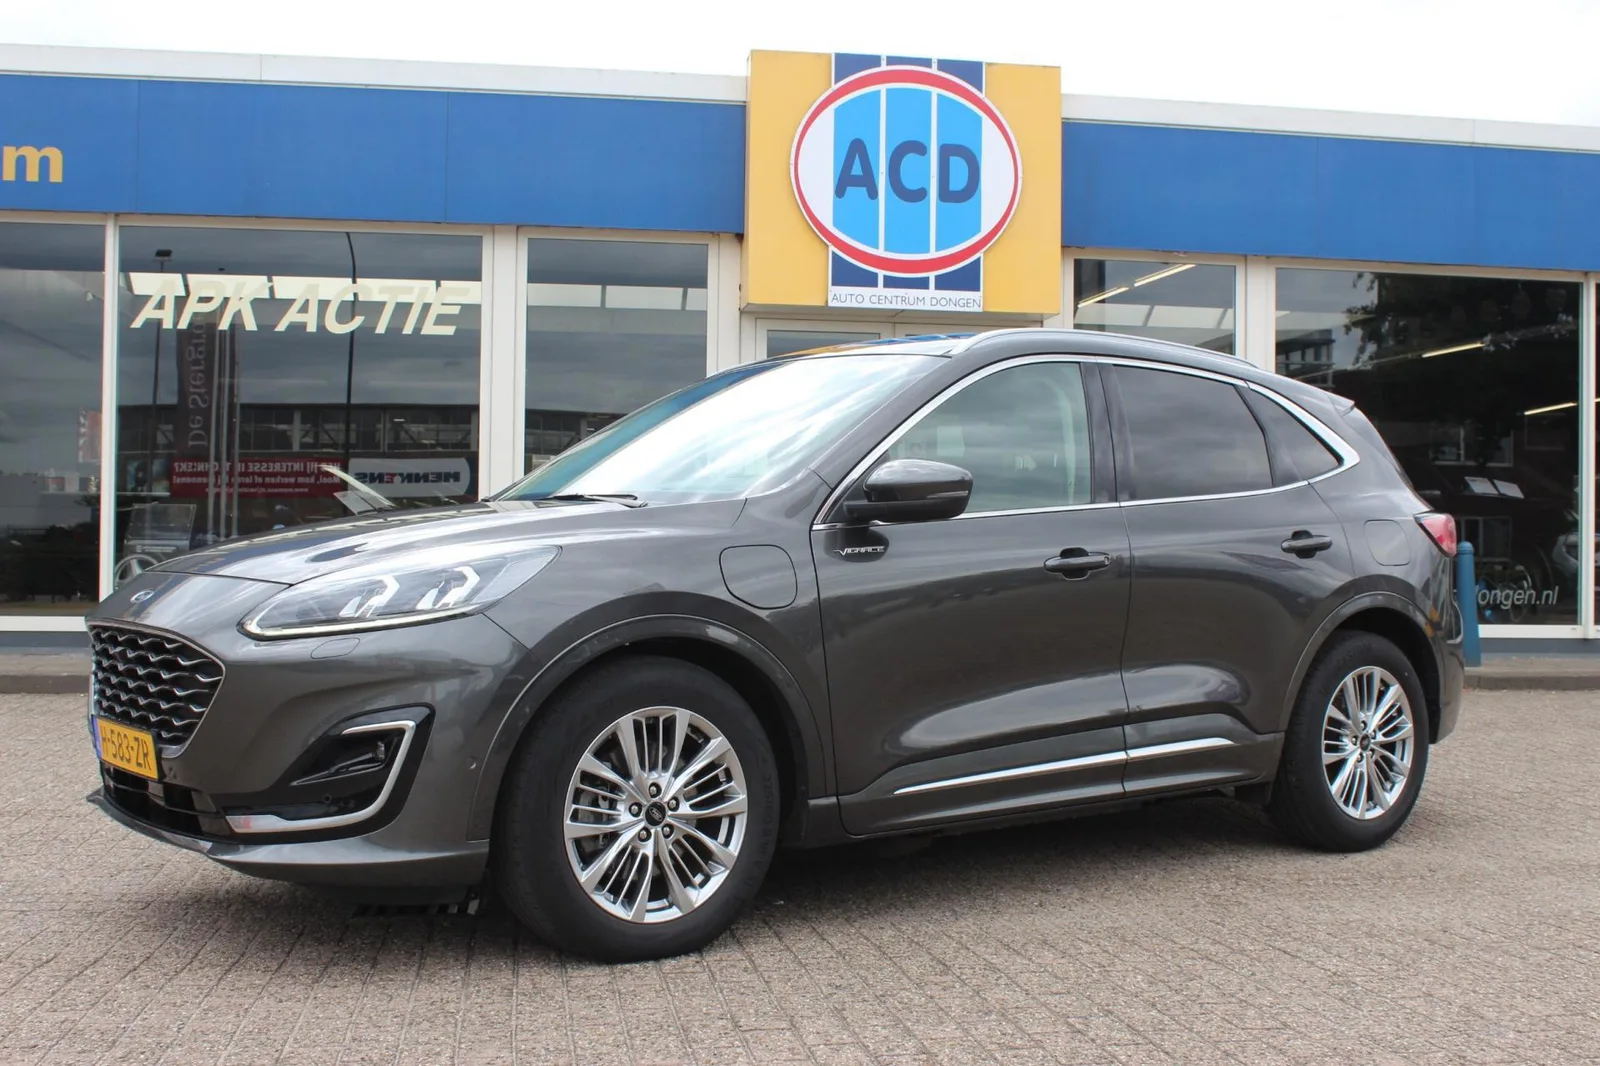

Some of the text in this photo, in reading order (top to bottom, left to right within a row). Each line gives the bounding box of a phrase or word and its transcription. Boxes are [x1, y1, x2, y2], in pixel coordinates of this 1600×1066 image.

[3, 145, 63, 183] m
[835, 138, 980, 203] ACD
[129, 278, 470, 335] APK ACTIE
[831, 293, 981, 308] AUTO CENTRUM DONGEN
